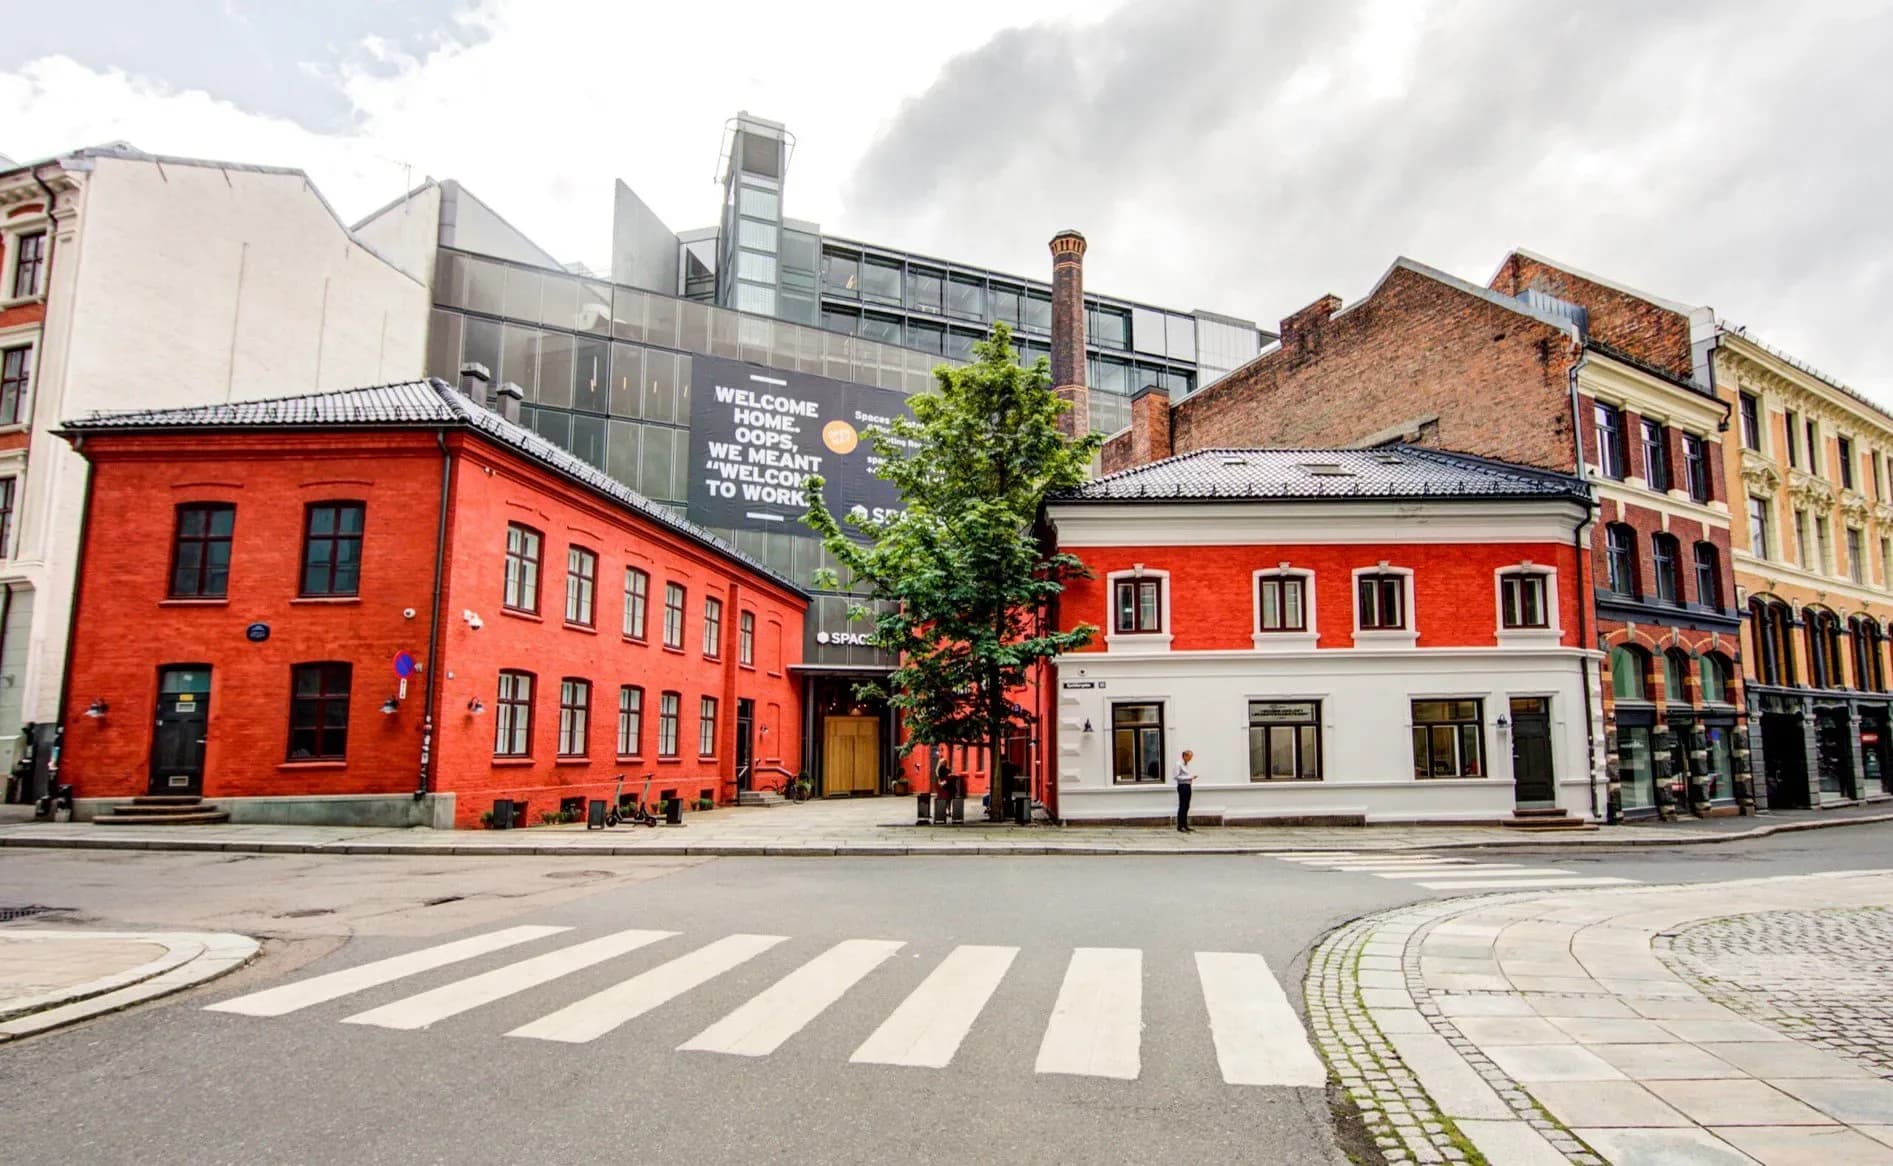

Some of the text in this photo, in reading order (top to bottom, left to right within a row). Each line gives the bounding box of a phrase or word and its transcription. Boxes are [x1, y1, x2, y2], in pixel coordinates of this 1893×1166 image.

[715, 385, 819, 418] WELCOME
[734, 407, 801, 433] HOME.
[855, 410, 890, 424] Spaces
[735, 427, 798, 453] OOPS,
[708, 441, 822, 472] WE MEANT
[705, 479, 736, 498] TO
